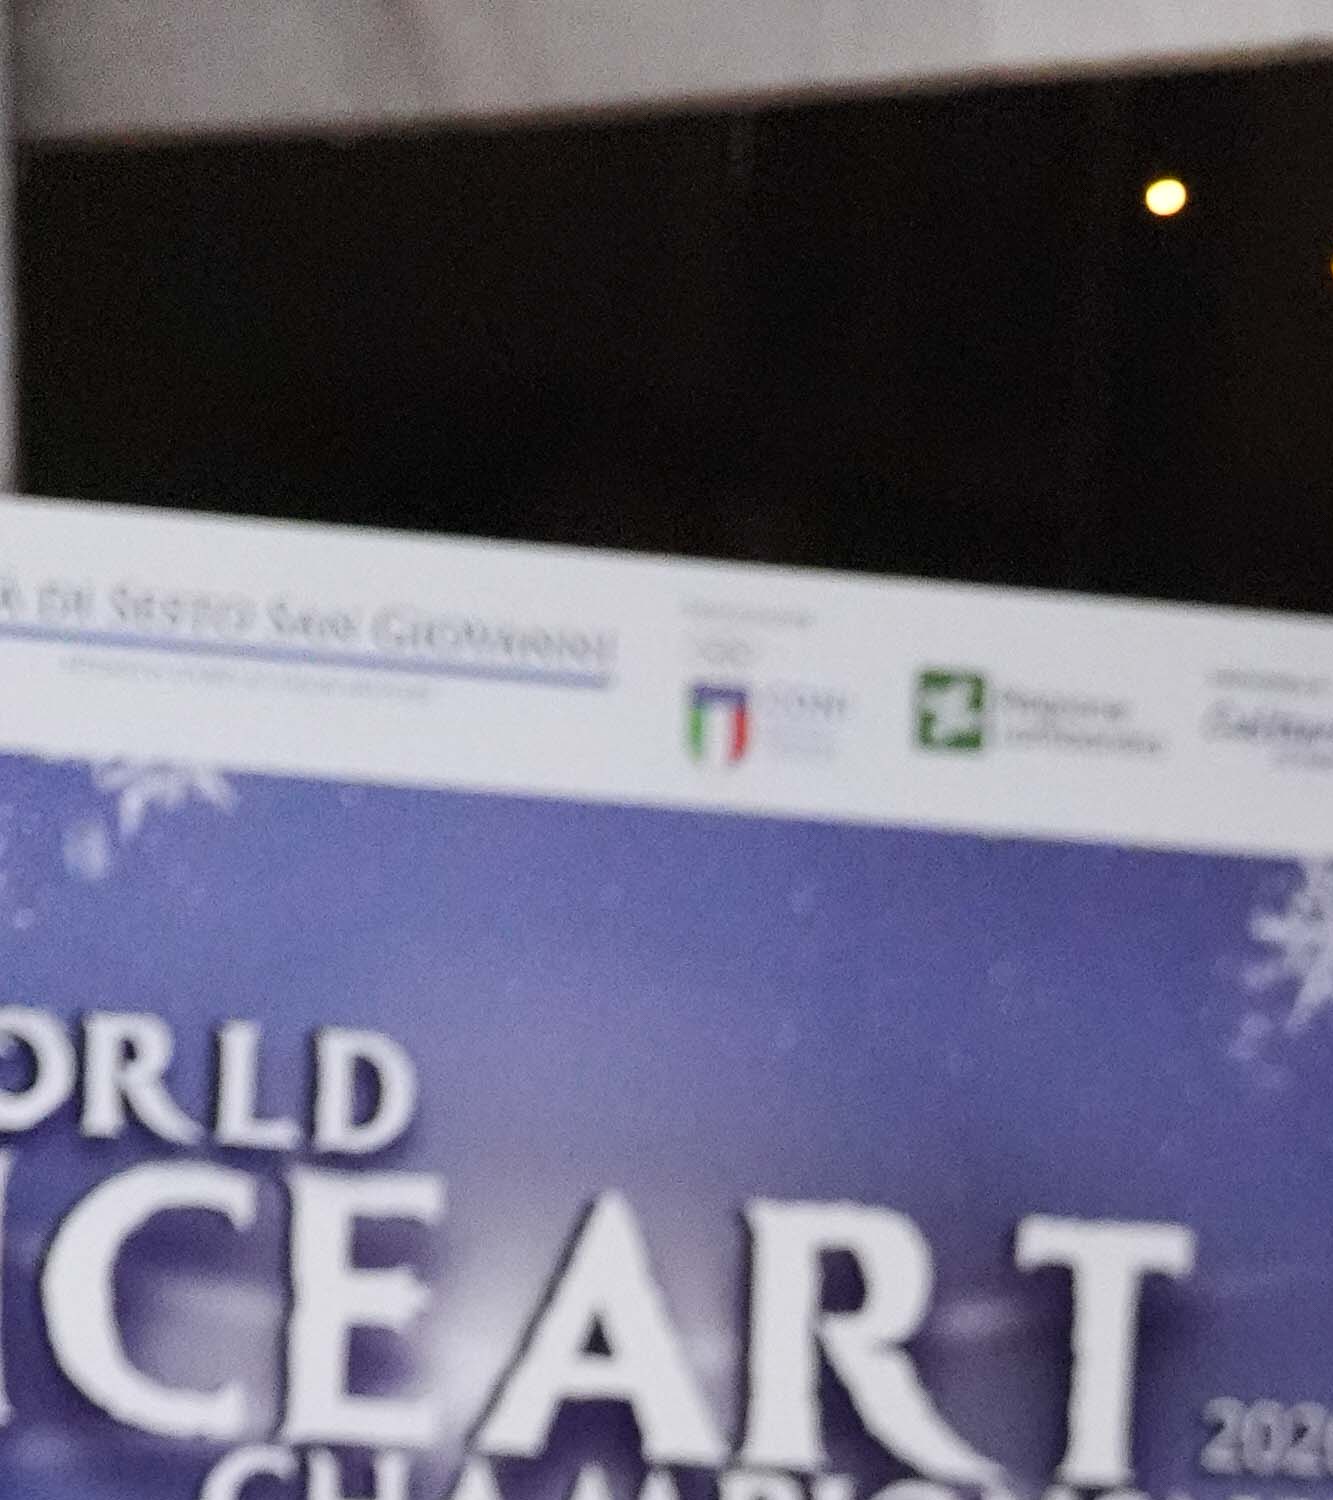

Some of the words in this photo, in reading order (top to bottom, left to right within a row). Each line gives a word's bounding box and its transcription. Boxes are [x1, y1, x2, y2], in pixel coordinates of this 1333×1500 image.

[0, 1008, 420, 1156] ORLD
[0, 1150, 448, 1450] CE
[474, 1188, 1196, 1493] ART
